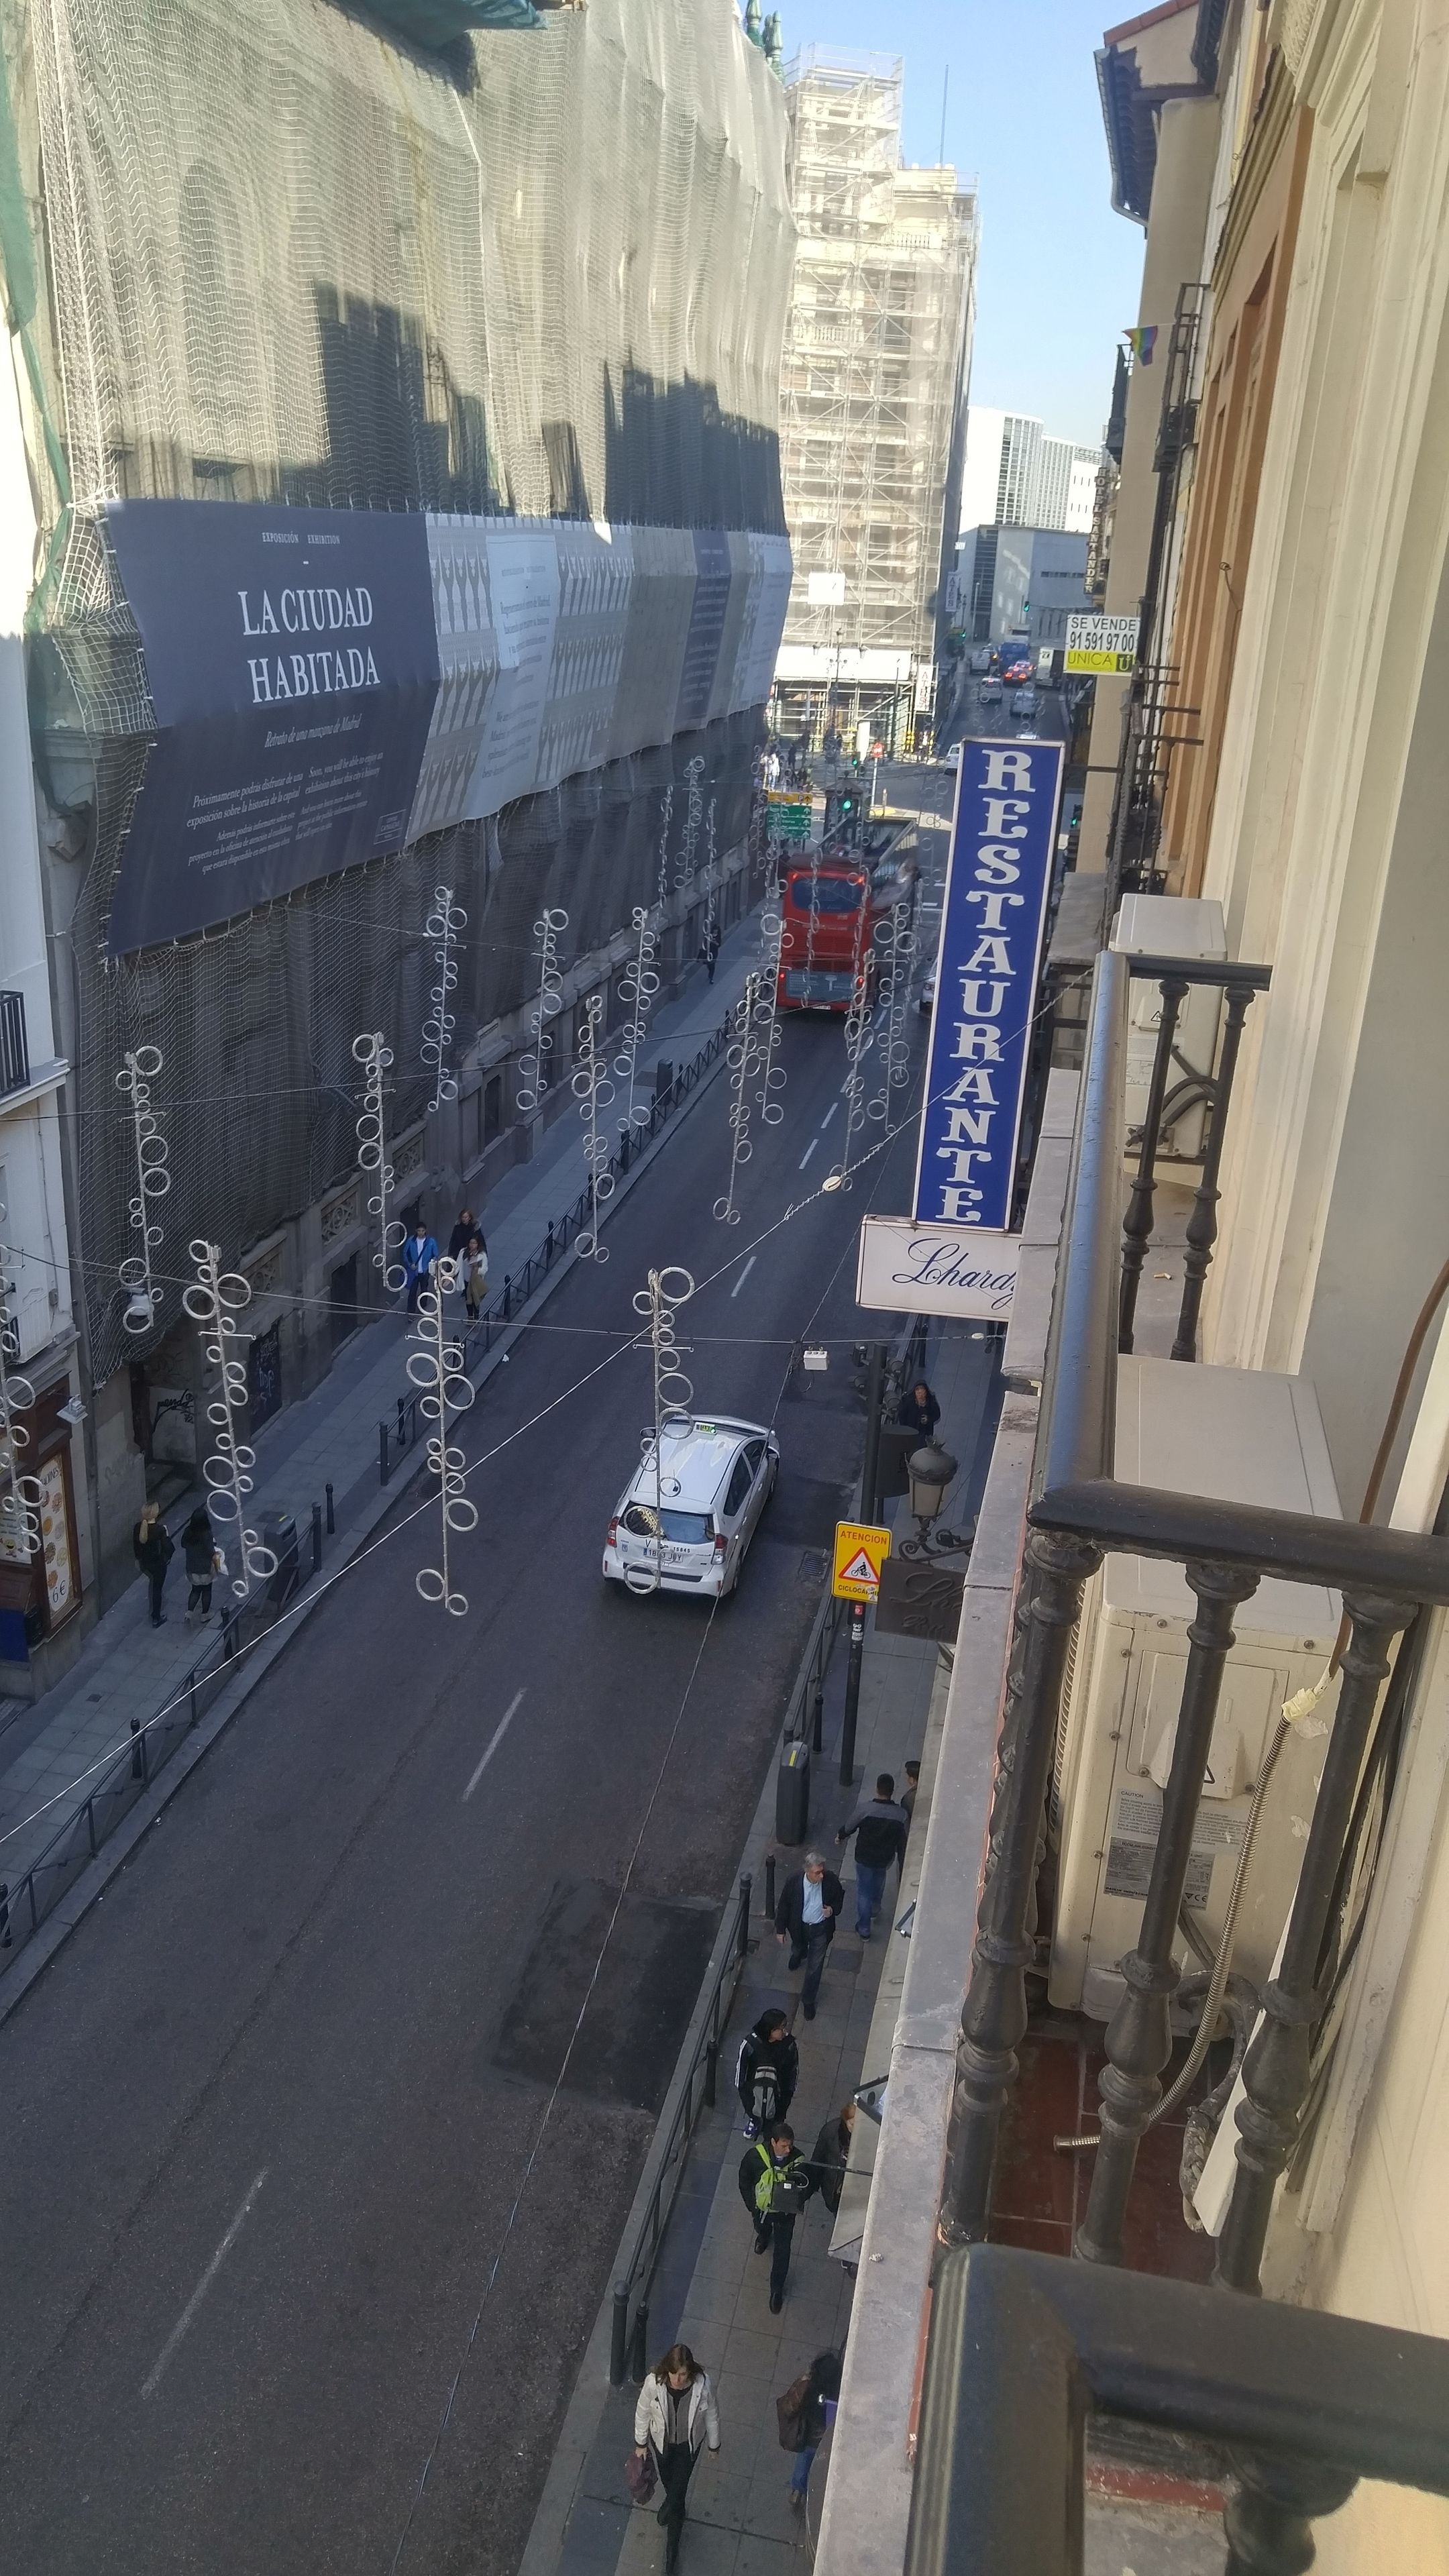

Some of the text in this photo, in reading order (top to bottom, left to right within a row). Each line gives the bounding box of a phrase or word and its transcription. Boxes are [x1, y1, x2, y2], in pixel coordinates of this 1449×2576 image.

[262, 531, 340, 544] EXPOSICIÓN EXHIBITION
[1085, 517, 1102, 593] SANTANDER
[237, 588, 373, 635] LA CIUDAD
[1071, 616, 1136, 631] SE VENDE
[1069, 631, 1134, 652] 91 591 97 00
[1067, 652, 1112, 665] UNICA
[247, 646, 380, 703] HABITADA
[264, 731, 288, 748] Retrato
[288, 727, 296, 743] de
[296, 730, 308, 741] una
[340, 713, 363, 732] Madrid
[193, 789, 241, 808] Próximamente
[262, 777, 286, 791] disfrutar
[186, 809, 223, 830] exposición
[223, 804, 241, 818] sobre
[936, 749, 1036, 1222] RESTAURANTE
[840, 1530, 888, 1545] ATENCION
[52, 1580, 66, 1603] 6€
[838, 1584, 879, 1595] CICLOCA
[1121, 1790, 1143, 1799] CAUTION
